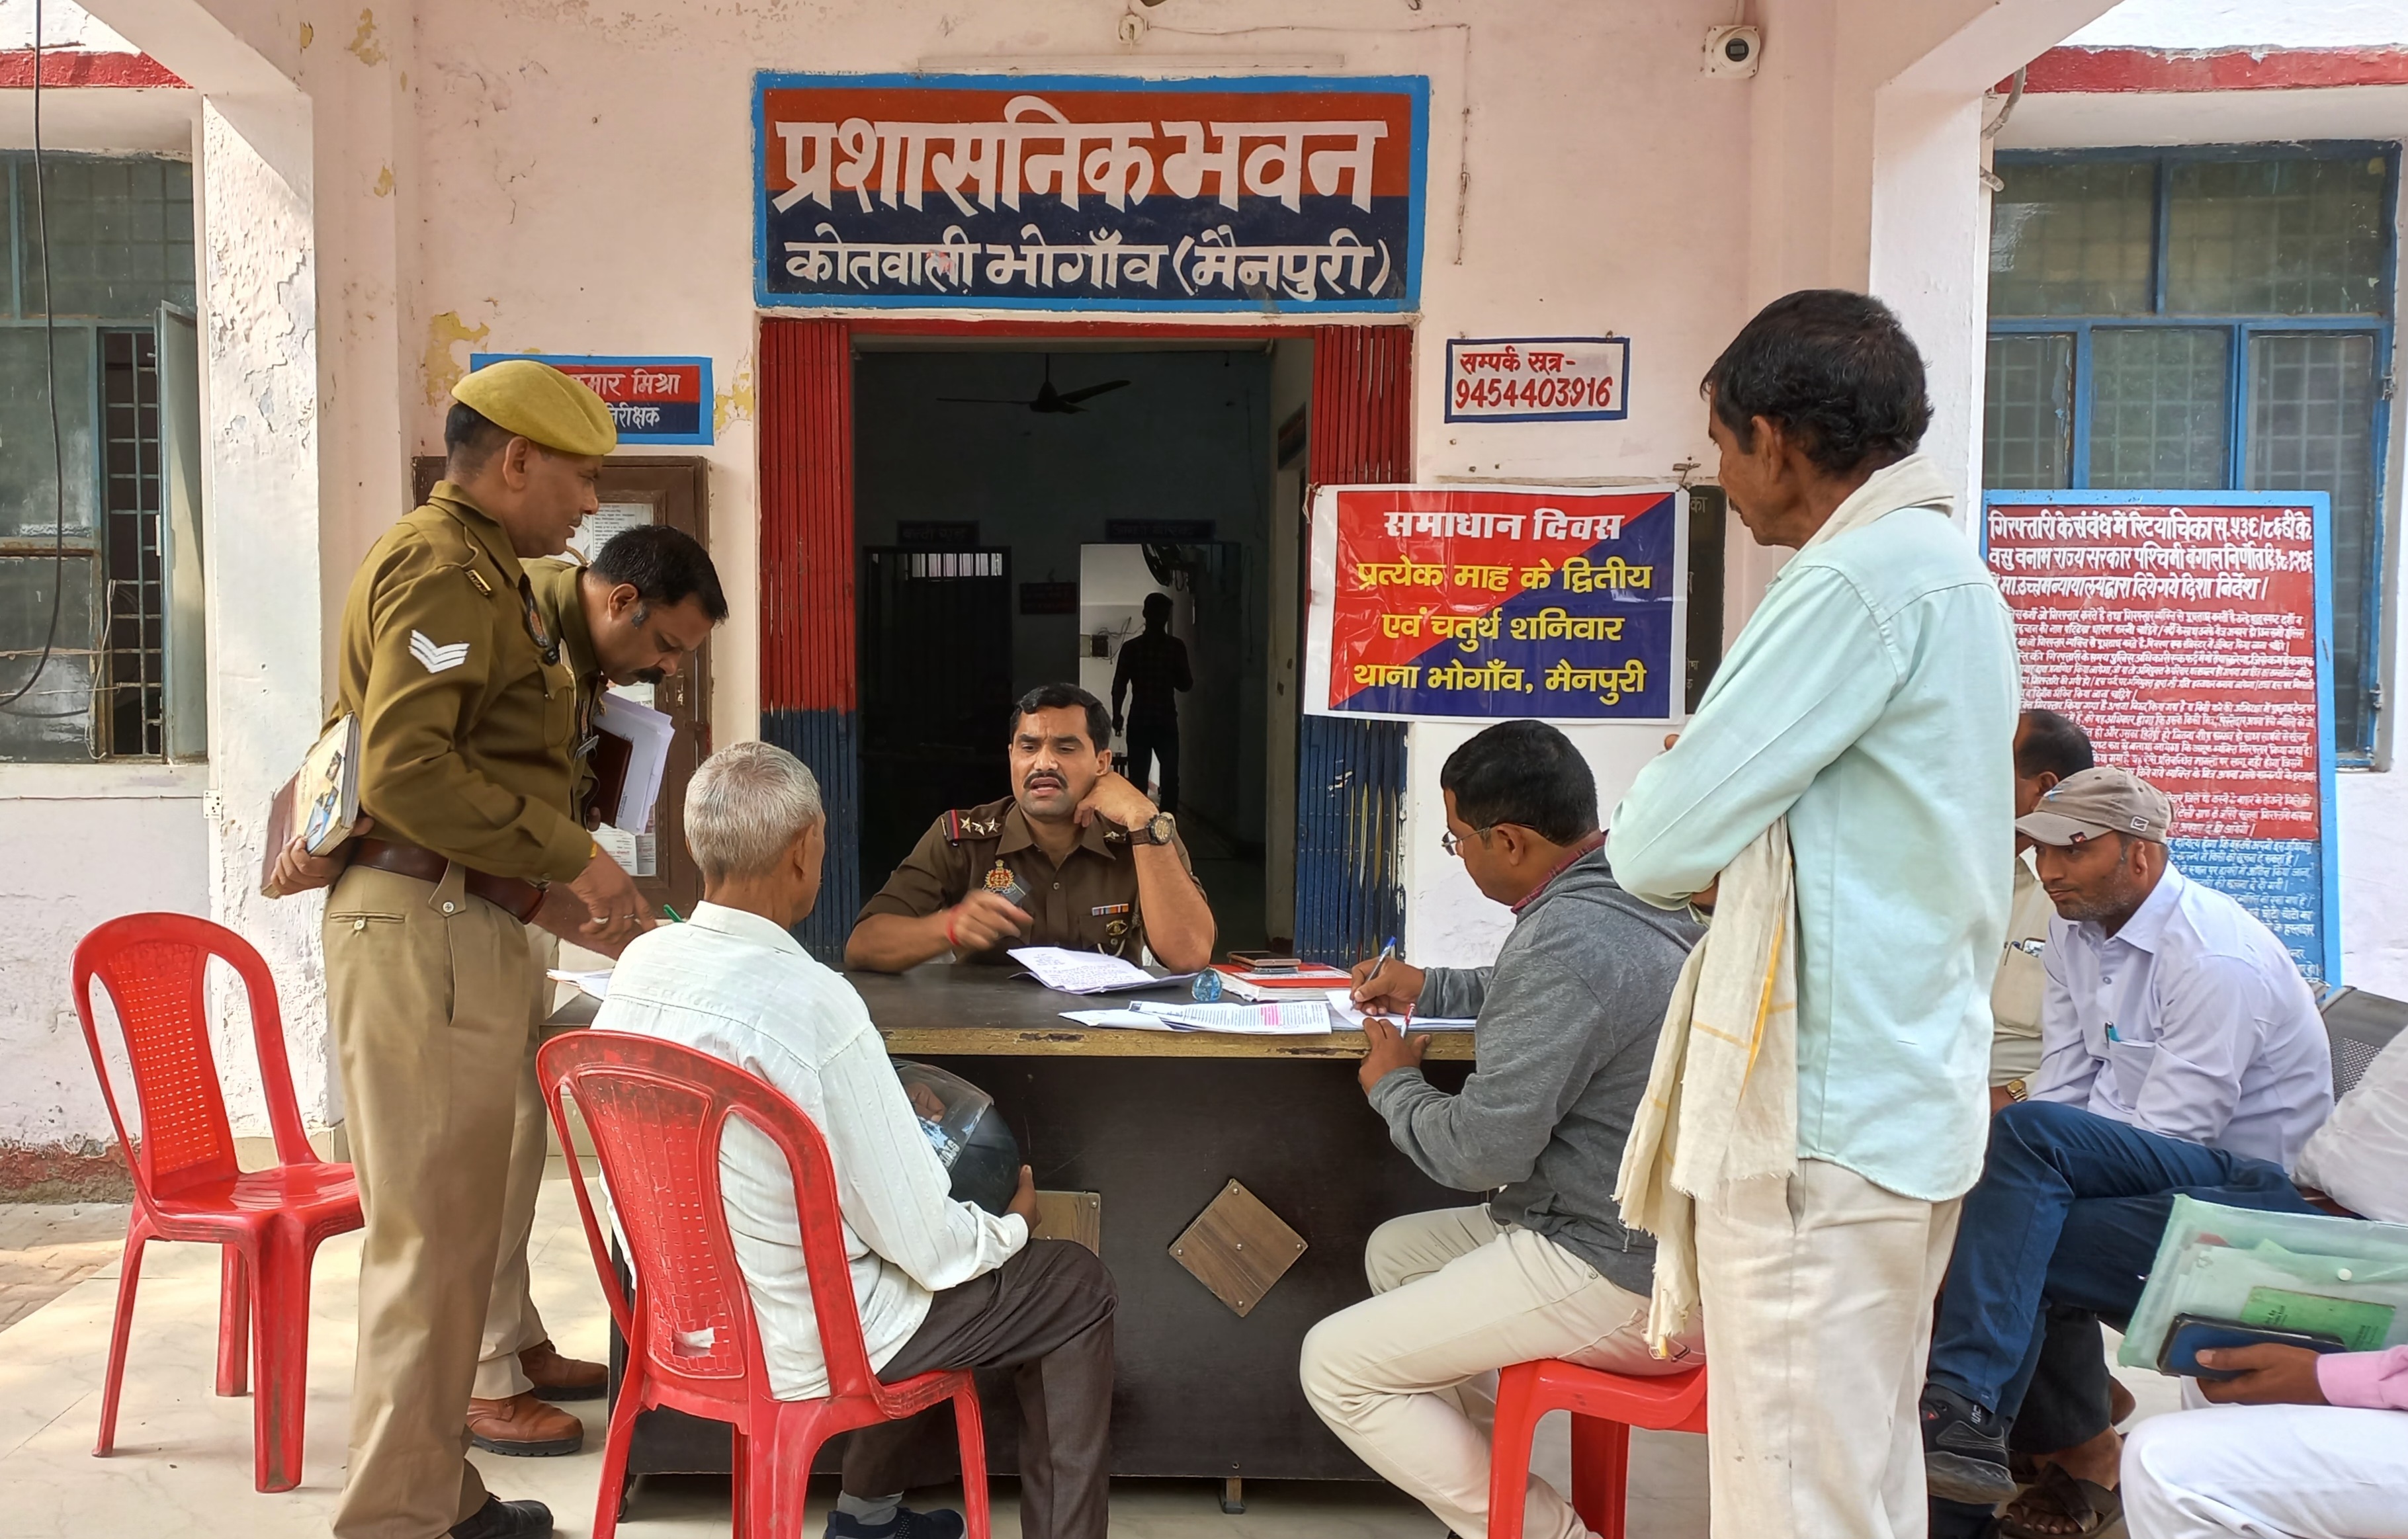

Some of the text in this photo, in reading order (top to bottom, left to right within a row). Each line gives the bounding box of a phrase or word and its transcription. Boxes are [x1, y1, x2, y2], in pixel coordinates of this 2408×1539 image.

[772, 95, 1388, 216] प्रशासनिक भवन
[785, 222, 1391, 302] कोतवाली भोगाँव (मैनपुरी)
[1460, 345, 1520, 374] सम्पर्क
[630, 368, 681, 395] मिश्रा
[1455, 375, 1613, 409] 9454403916
[1383, 507, 1625, 541] समाधान दिवस
[1988, 509, 2057, 541] गिरफ्तारी
[2056, 511, 2073, 540] के
[2112, 510, 2129, 539] में
[2154, 507, 2214, 541] याचिका
[1356, 555, 1447, 591] प्रत्येक
[1453, 566, 1512, 592] माह
[1520, 559, 1555, 591] के
[1563, 556, 1653, 594] द्वितीय
[2053, 548, 2086, 570] राज्य
[2086, 548, 2133, 570] सरकार
[2106, 577, 2132, 600] द्वारा
[2132, 572, 2159, 601] दिये
[2157, 572, 2183, 599] गये
[2182, 573, 2215, 602] दिशा
[2215, 571, 2262, 601] निर्देश
[1383, 607, 1625, 652] एवं चतुर्थ शनिवार
[2046, 649, 2082, 663] गिरफ्तारी
[2089, 653, 2110, 663] समय
[1354, 663, 1420, 687] थाना
[1428, 659, 1534, 695] भोगाँव,
[1545, 659, 1646, 706] मैनपुरी
[2104, 726, 2120, 739] और
[2106, 712, 2136, 726] अधिकार
[2165, 766, 2192, 780] व्यक्ति
